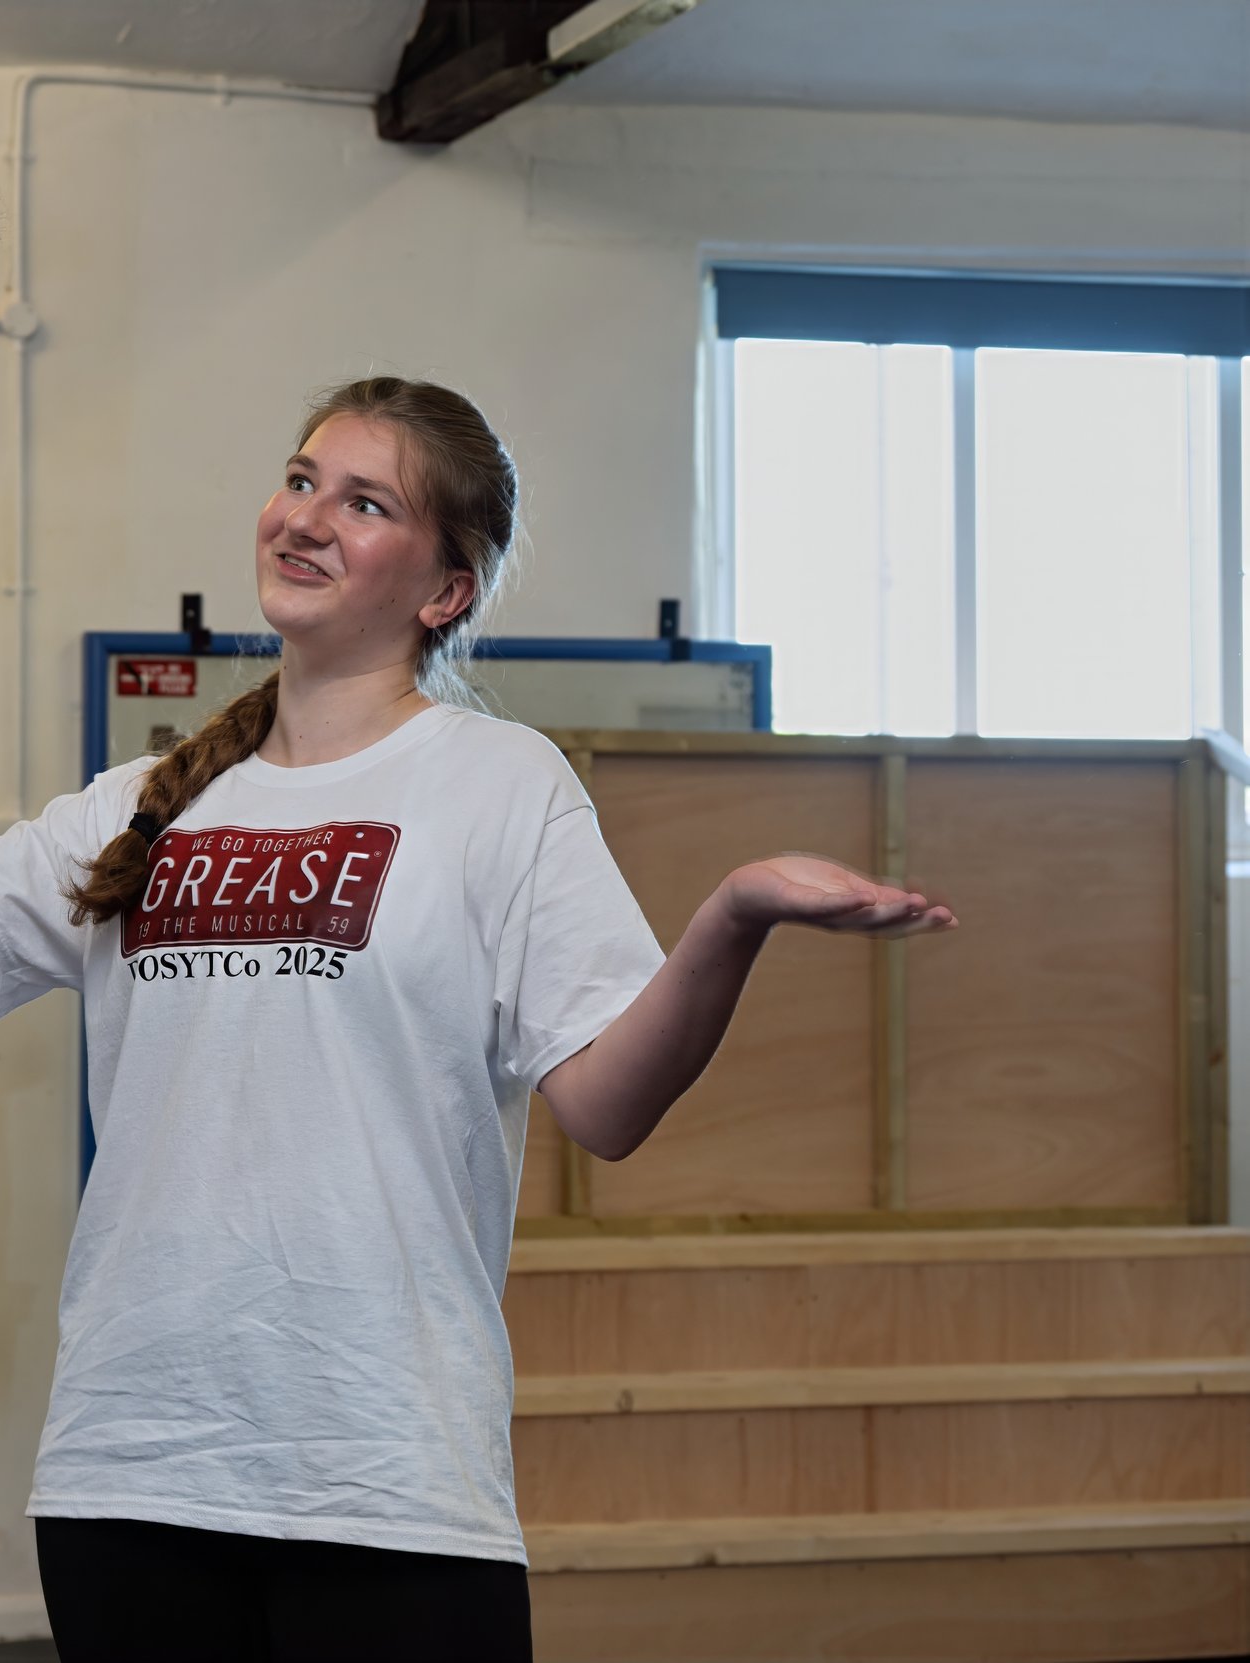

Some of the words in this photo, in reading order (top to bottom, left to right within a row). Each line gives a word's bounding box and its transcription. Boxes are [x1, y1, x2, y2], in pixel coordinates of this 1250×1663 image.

[192, 836, 213, 851] WE
[221, 836, 244, 851] GO
[253, 831, 334, 852] TOGETHER
[142, 850, 370, 913] GREASE
[138, 921, 150, 940] 19
[163, 916, 197, 934] THE
[211, 913, 304, 932] MUSICAL
[327, 916, 350, 935] 59
[275, 946, 349, 980] 2025
